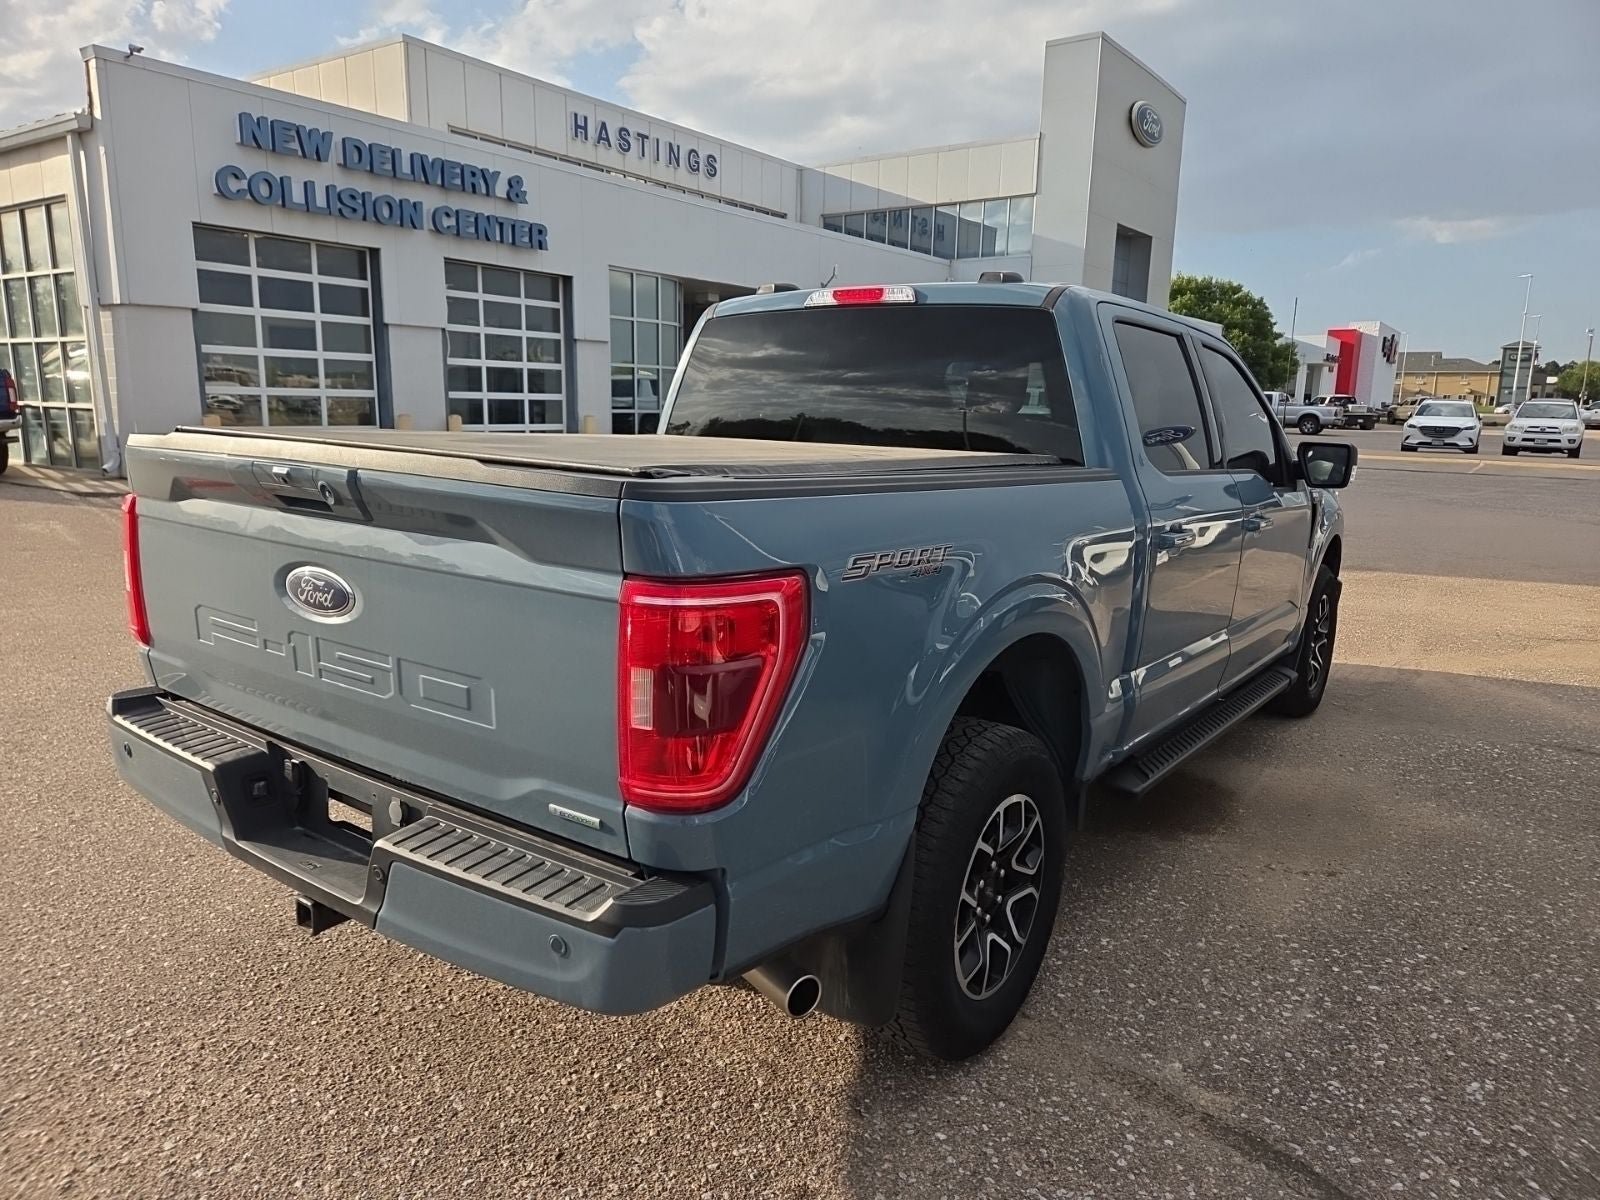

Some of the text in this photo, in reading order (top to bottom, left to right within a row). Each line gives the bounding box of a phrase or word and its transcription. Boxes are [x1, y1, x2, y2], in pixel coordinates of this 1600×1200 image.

[571, 112, 721, 179] HASTINGS
[1143, 109, 1161, 138] Ford
[236, 111, 529, 205] NEW DELIVERY &
[213, 164, 550, 251] COLLISION CENTER
[297, 575, 335, 608] Ford
[841, 543, 953, 582] SPORT
[195, 604, 496, 729] F-150
